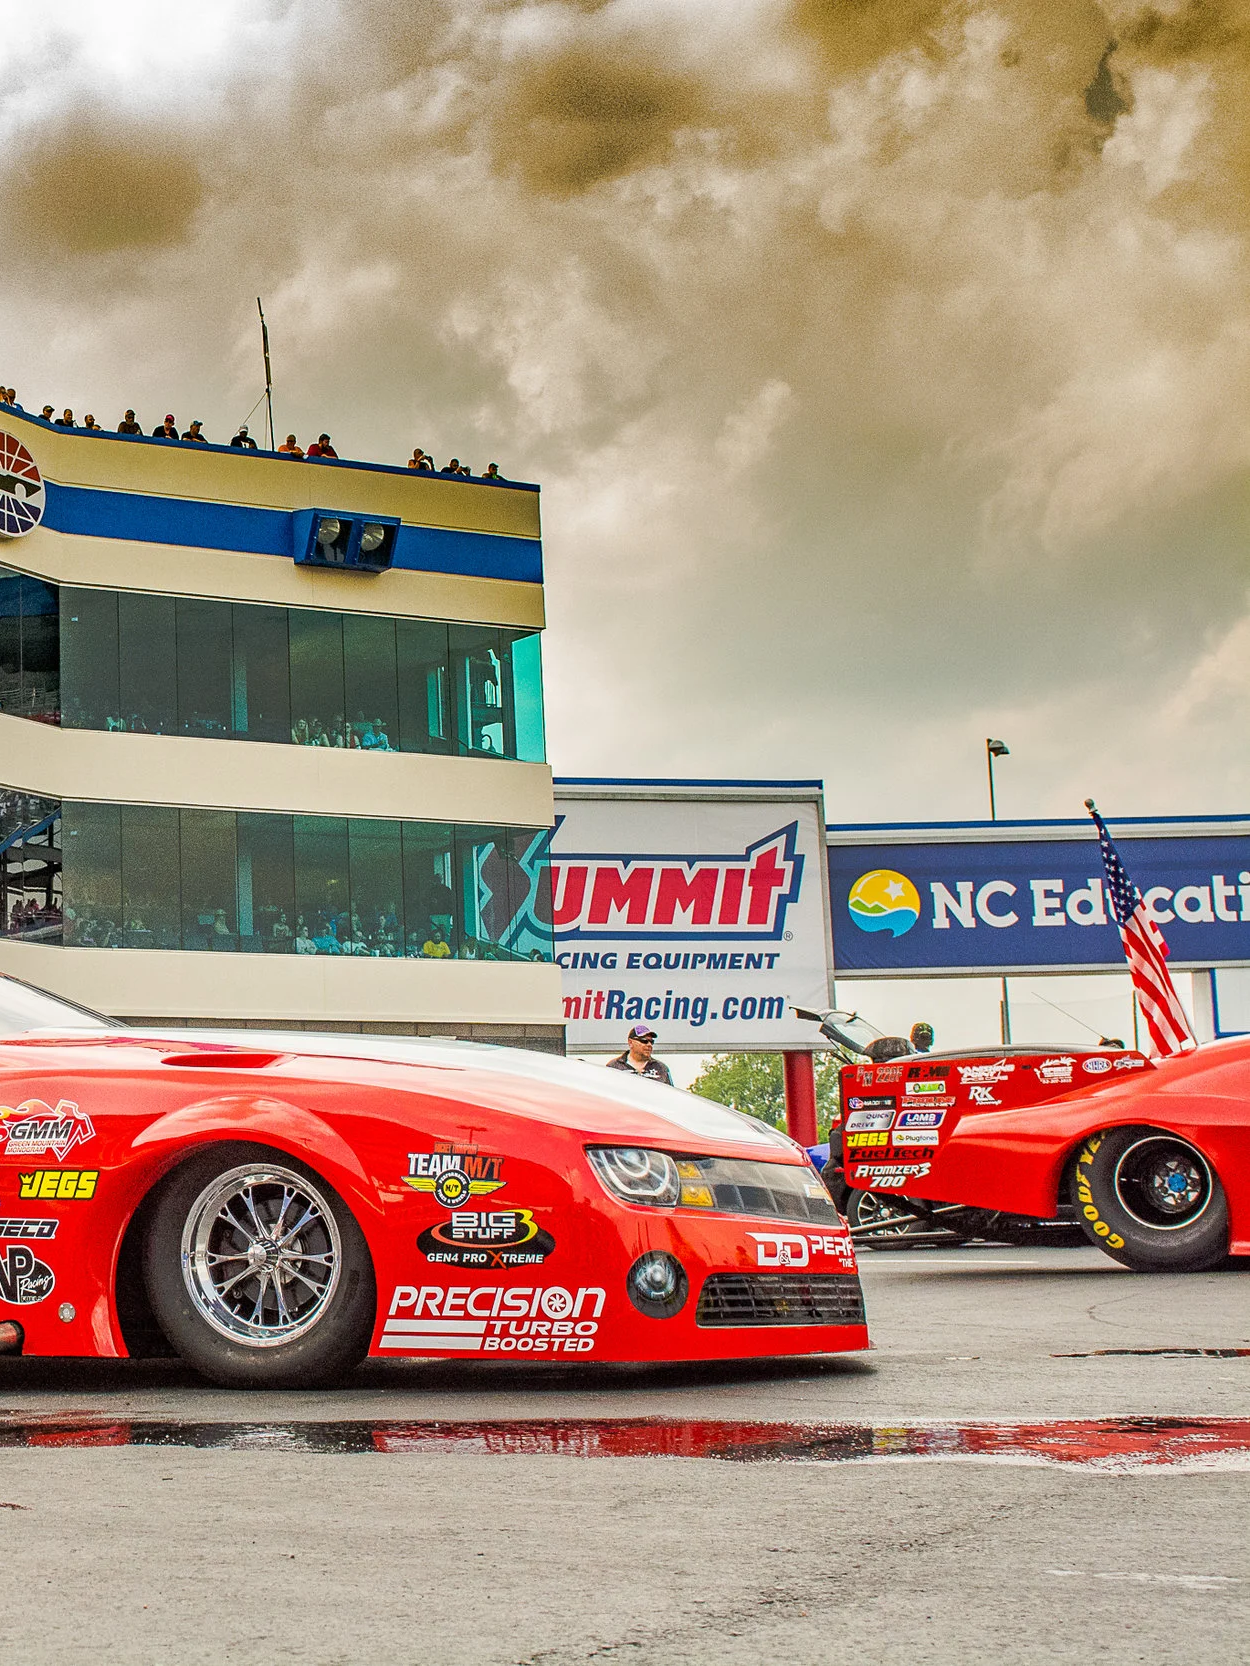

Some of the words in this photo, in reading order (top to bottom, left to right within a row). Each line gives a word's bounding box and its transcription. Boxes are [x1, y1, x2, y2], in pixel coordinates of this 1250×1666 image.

[930, 881, 1019, 928] NC
[625, 952, 781, 970] EQUIPMENT
[1086, 1060, 1110, 1070] NHRA
[968, 1086, 994, 1100] RK
[850, 1121, 875, 1129] DRIVE
[906, 1113, 937, 1122] LAMB
[11, 1121, 73, 1140] GMM
[847, 1132, 889, 1147] JEGS
[407, 1153, 461, 1176] TEAM
[463, 1156, 504, 1179] M/T
[21, 1171, 98, 1199] JEGS
[445, 1183, 459, 1193] M/T
[869, 1175, 907, 1188] 700
[452, 1212, 516, 1228] BIG
[452, 1228, 516, 1239] STUFF
[427, 1253, 459, 1263] GEN4
[462, 1252, 487, 1263] PRO
[20, 1274, 54, 1294] Racing
[388, 1285, 606, 1319] PRECISION
[489, 1320, 598, 1336] TURBO
[483, 1336, 595, 1352] BOOSTED
